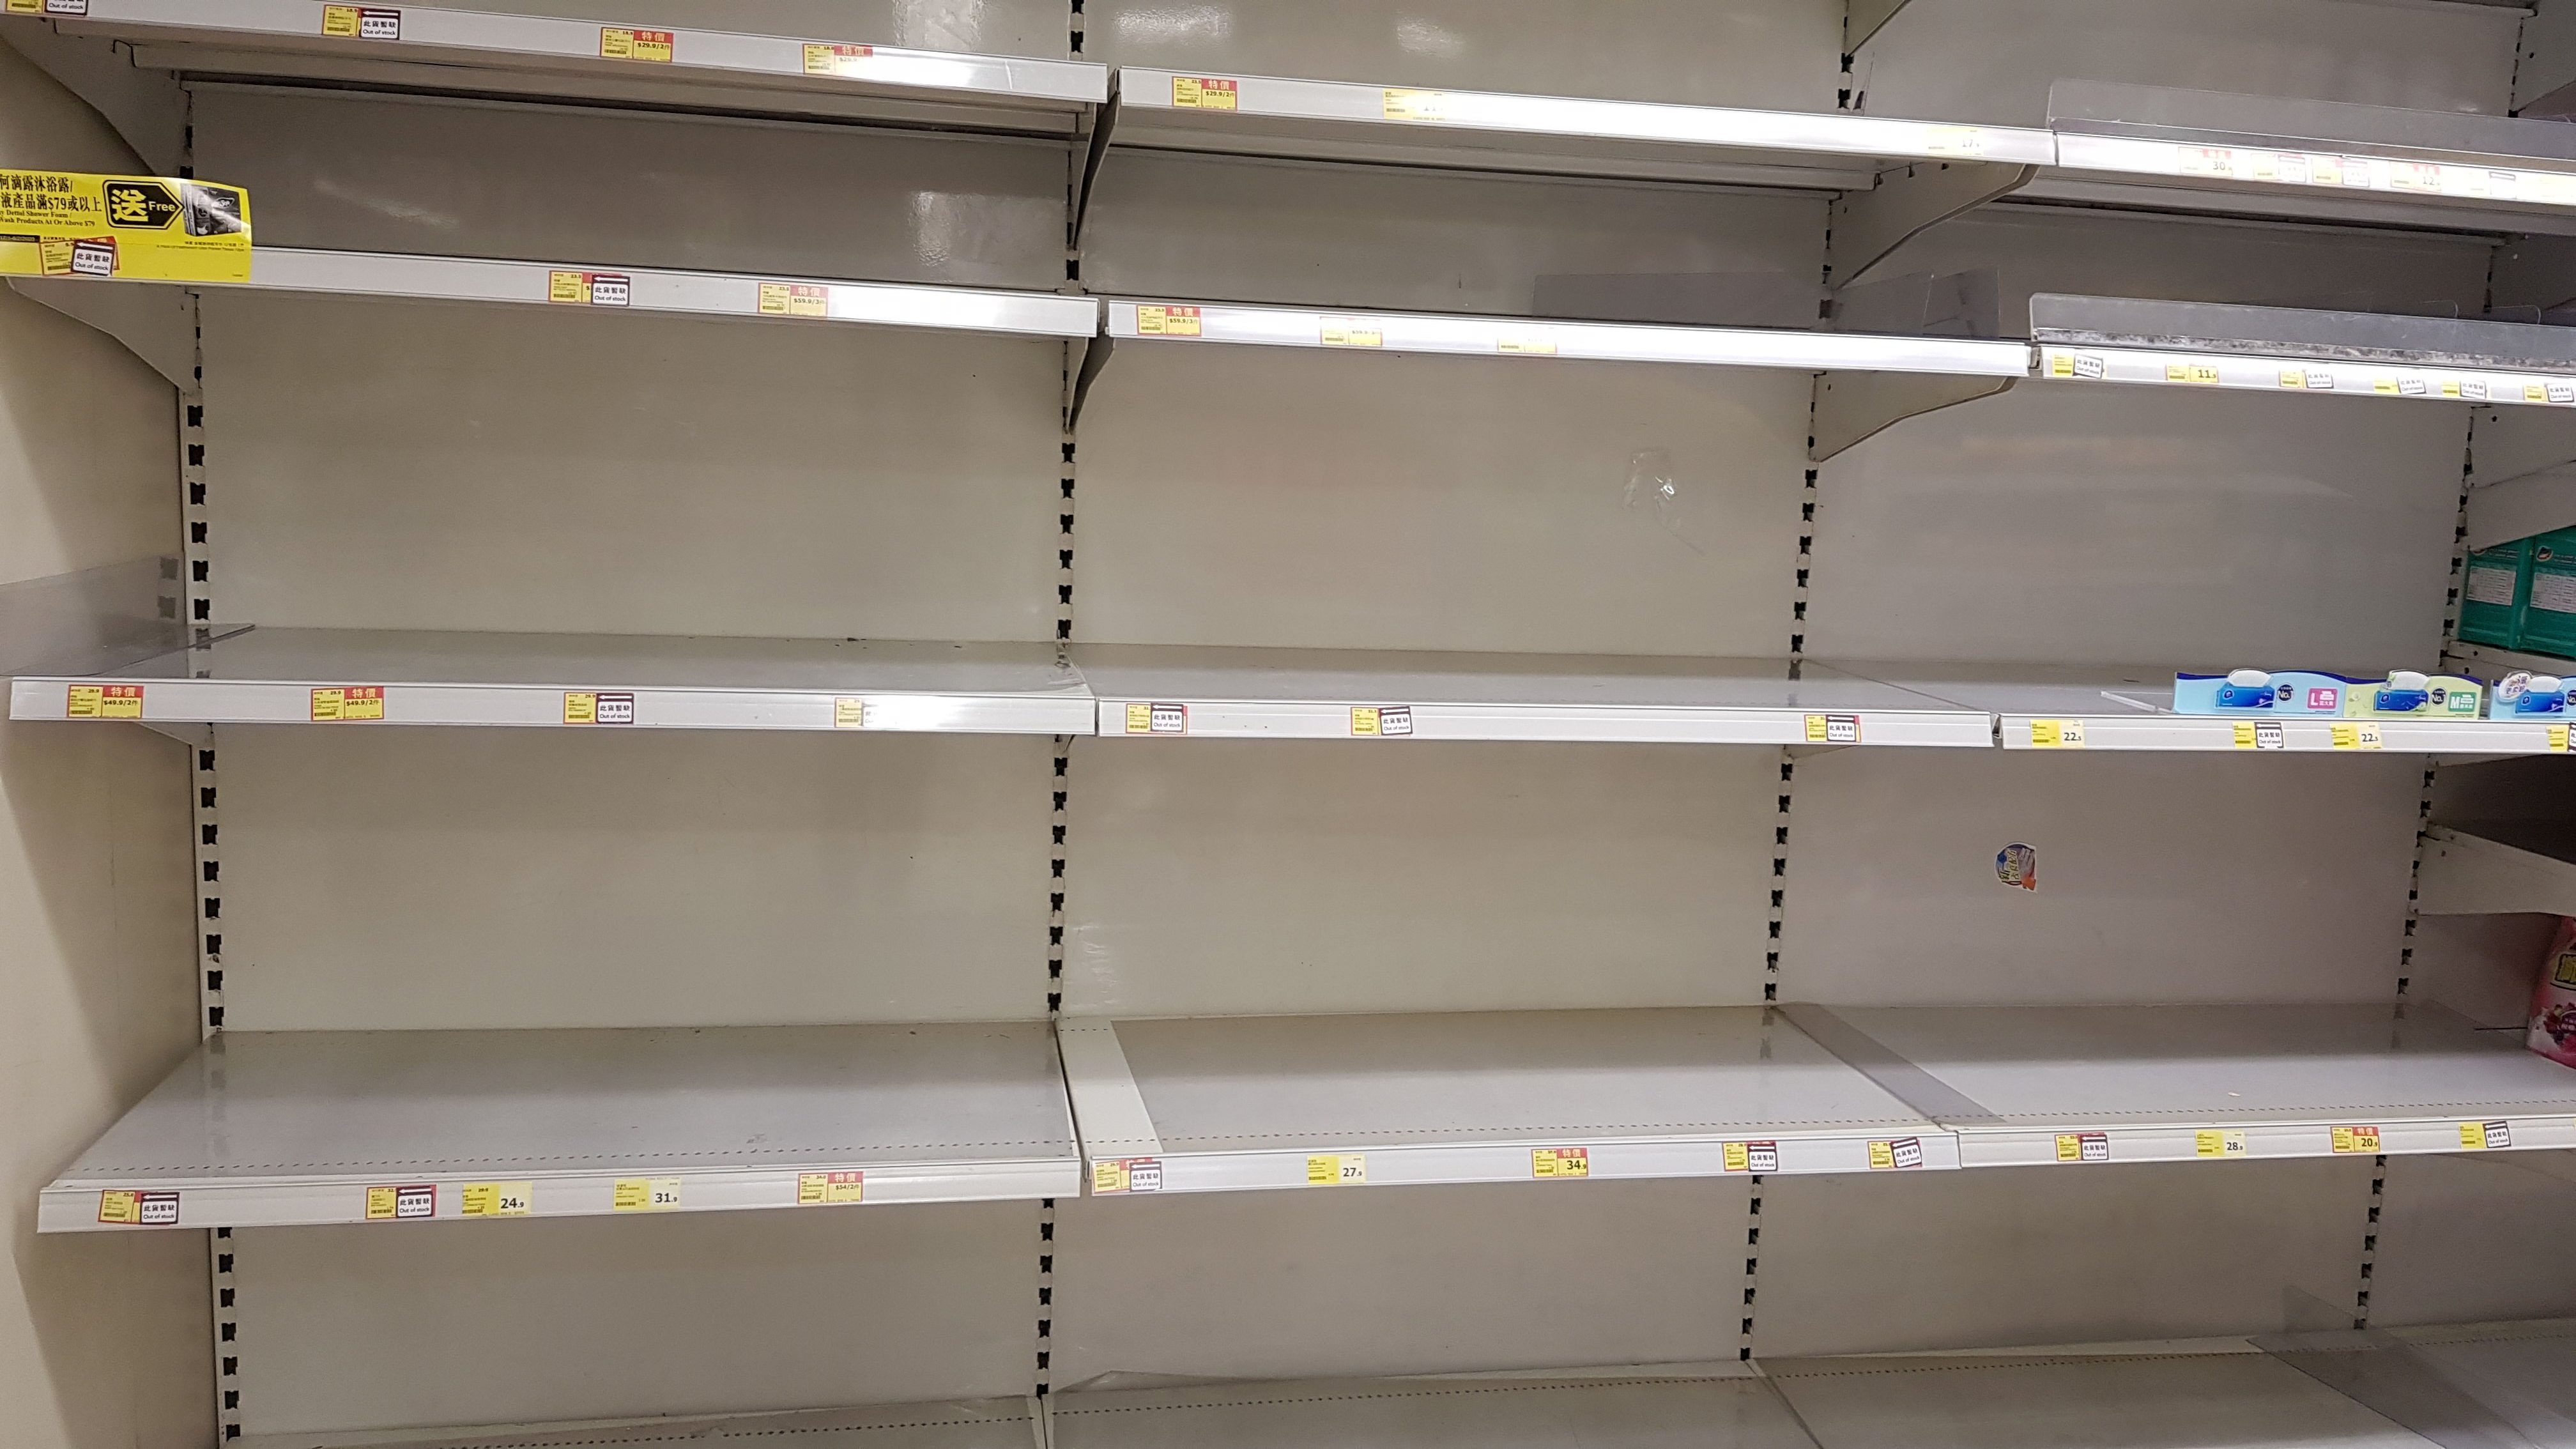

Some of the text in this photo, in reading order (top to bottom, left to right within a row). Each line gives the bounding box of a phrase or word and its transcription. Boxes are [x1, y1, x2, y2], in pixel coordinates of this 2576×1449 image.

[641, 31, 665, 42] 特價
[1208, 79, 1230, 90] 特價
[111, 188, 149, 222] 送
[148, 201, 176, 212] Free
[111, 686, 136, 697] 特價
[352, 688, 376, 698] 特價
[2310, 692, 2319, 706] L
[2450, 696, 2460, 709] M
[2226, 1142, 2243, 1151] 28.9
[2361, 1138, 2378, 1147] 20.9
[1567, 1160, 1586, 1170] 34.9
[1342, 1167, 1362, 1177] 27.9
[500, 1197, 525, 1209] 24.9
[654, 1192, 678, 1203] 31.9
